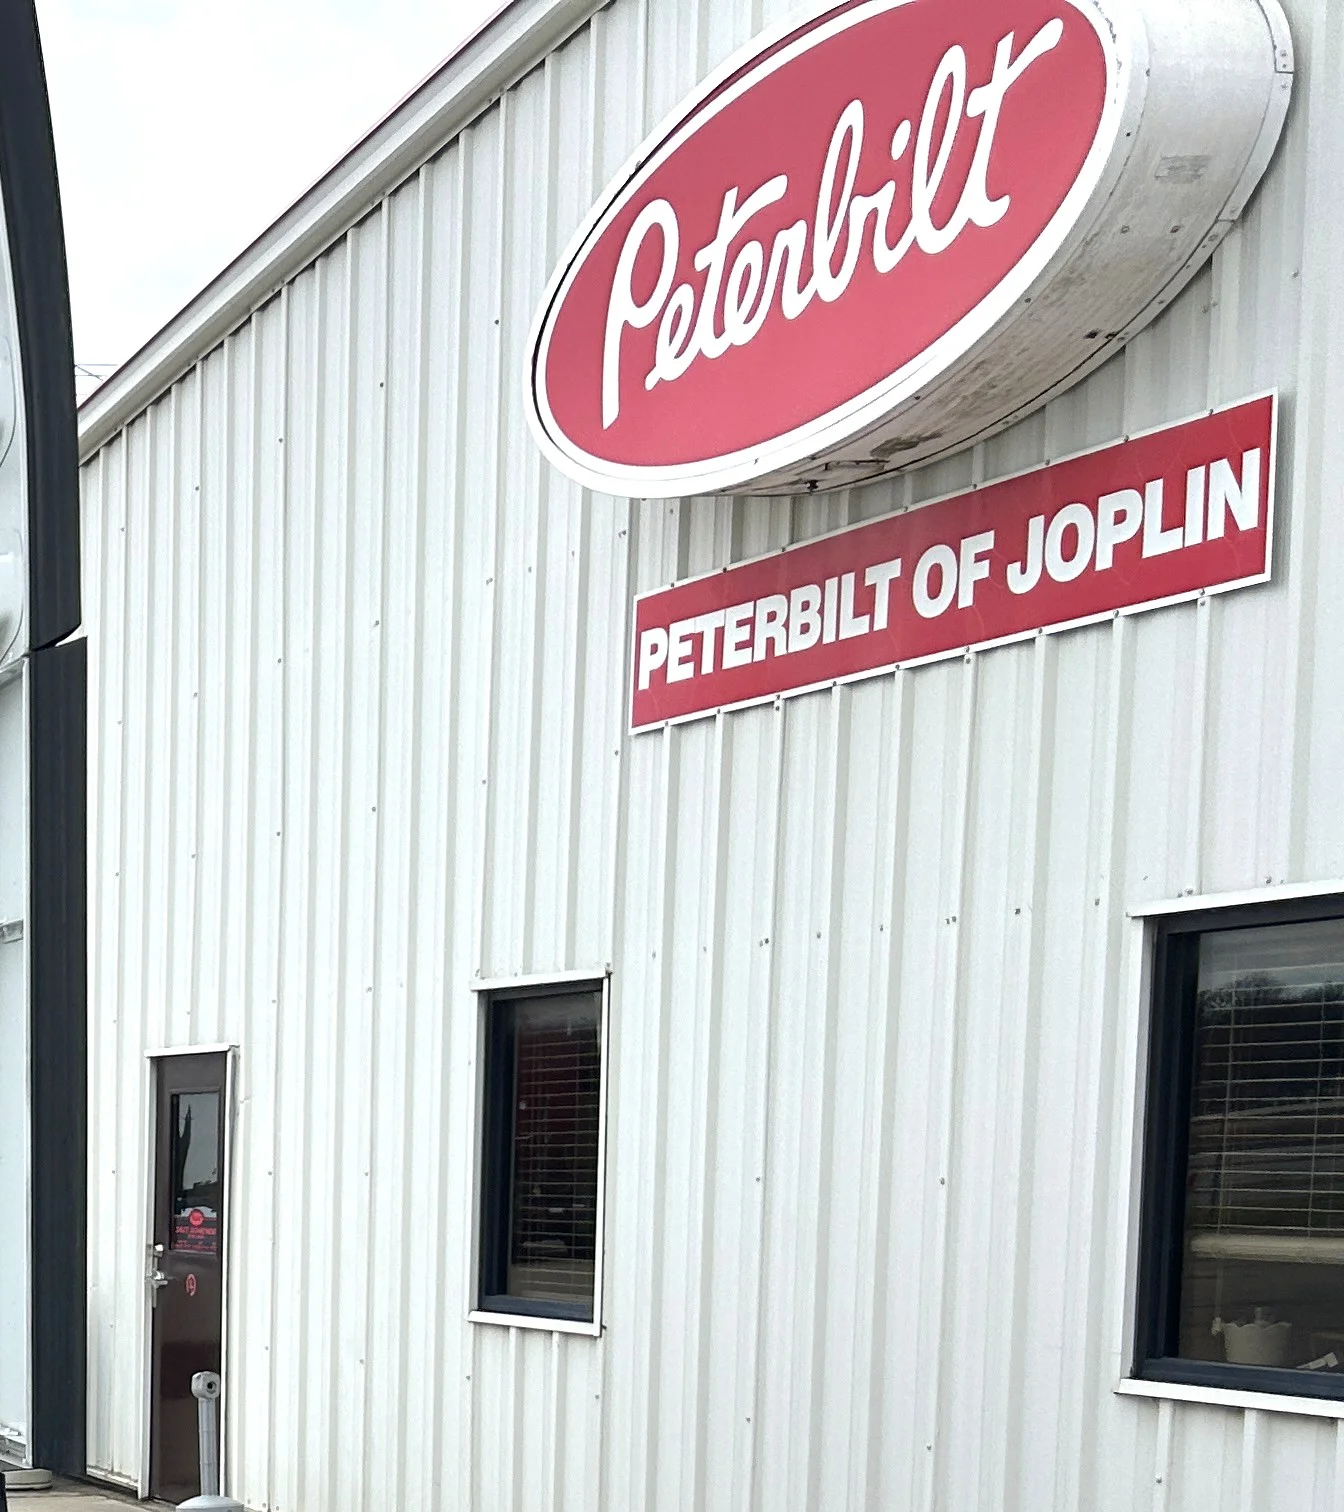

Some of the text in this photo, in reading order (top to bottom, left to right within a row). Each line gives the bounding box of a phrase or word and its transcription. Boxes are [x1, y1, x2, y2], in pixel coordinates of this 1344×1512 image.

[601, 18, 1065, 431] Peterbilt
[637, 447, 1262, 692] PETERBILT OF JOPLIN
